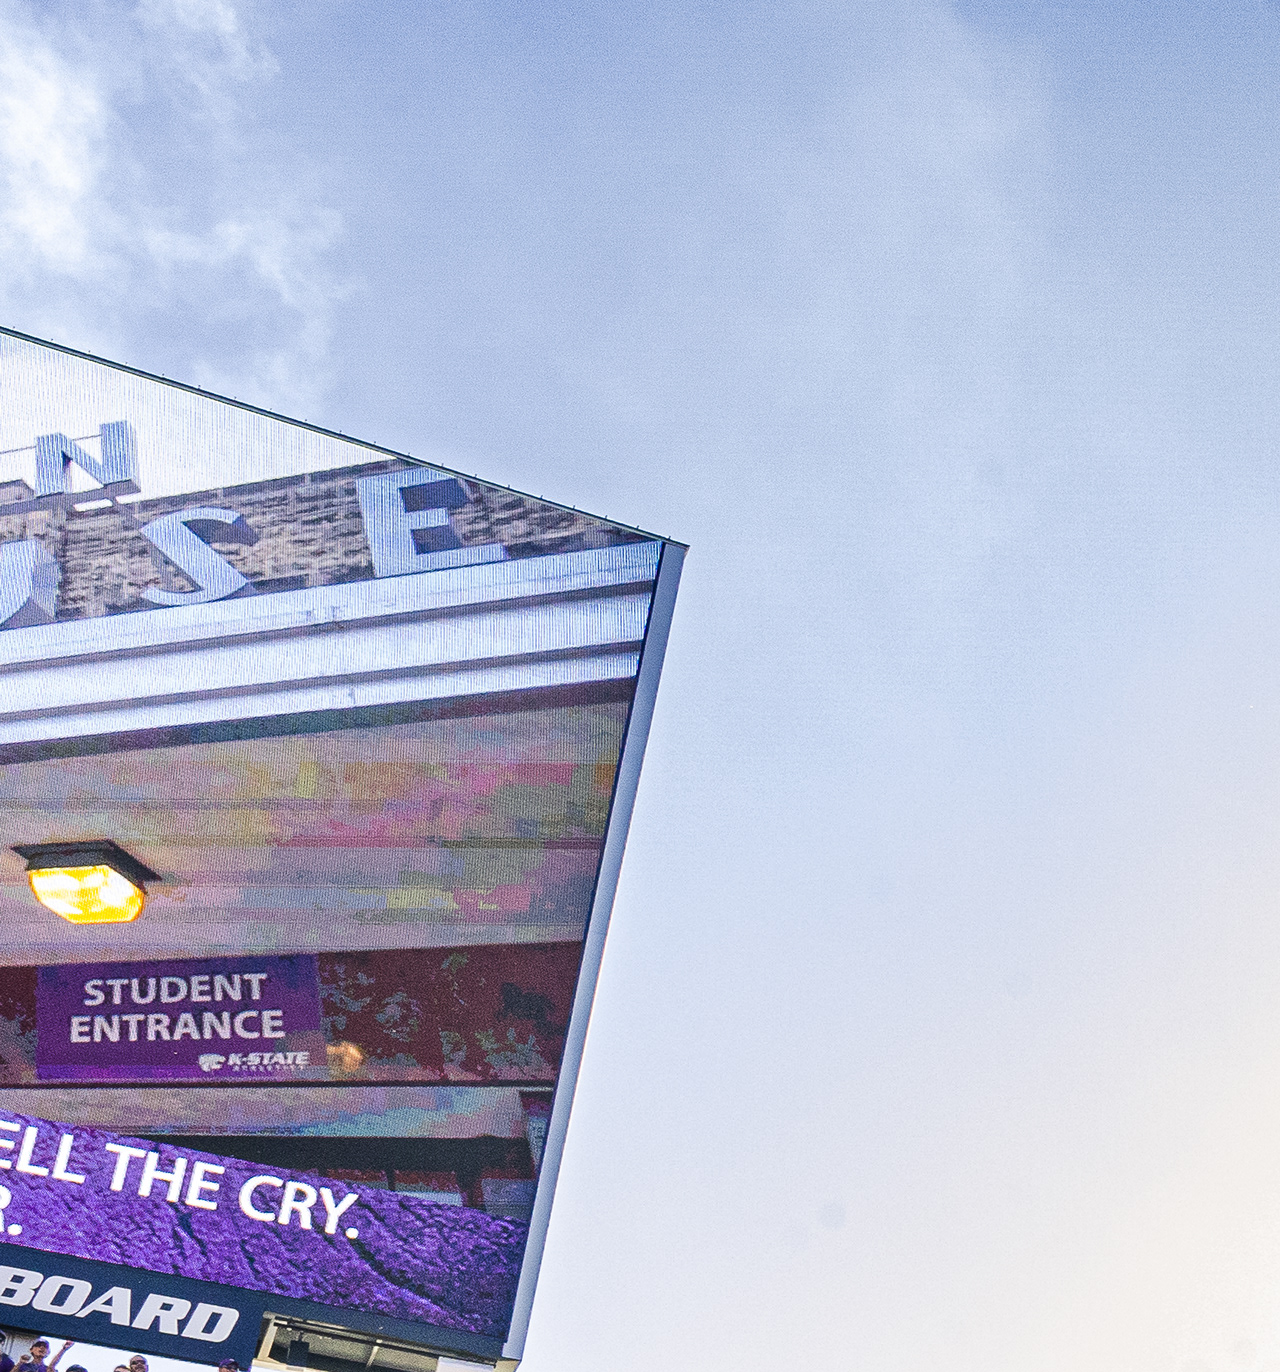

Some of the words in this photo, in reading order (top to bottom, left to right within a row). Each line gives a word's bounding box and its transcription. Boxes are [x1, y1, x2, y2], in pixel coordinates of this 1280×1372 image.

[83, 974, 268, 1007] STUDENT
[70, 1010, 286, 1043] ENTRANCE
[104, 1141, 226, 1211] THE
[237, 1177, 360, 1239] CRY.
[0, 1265, 240, 1344] BOARD
